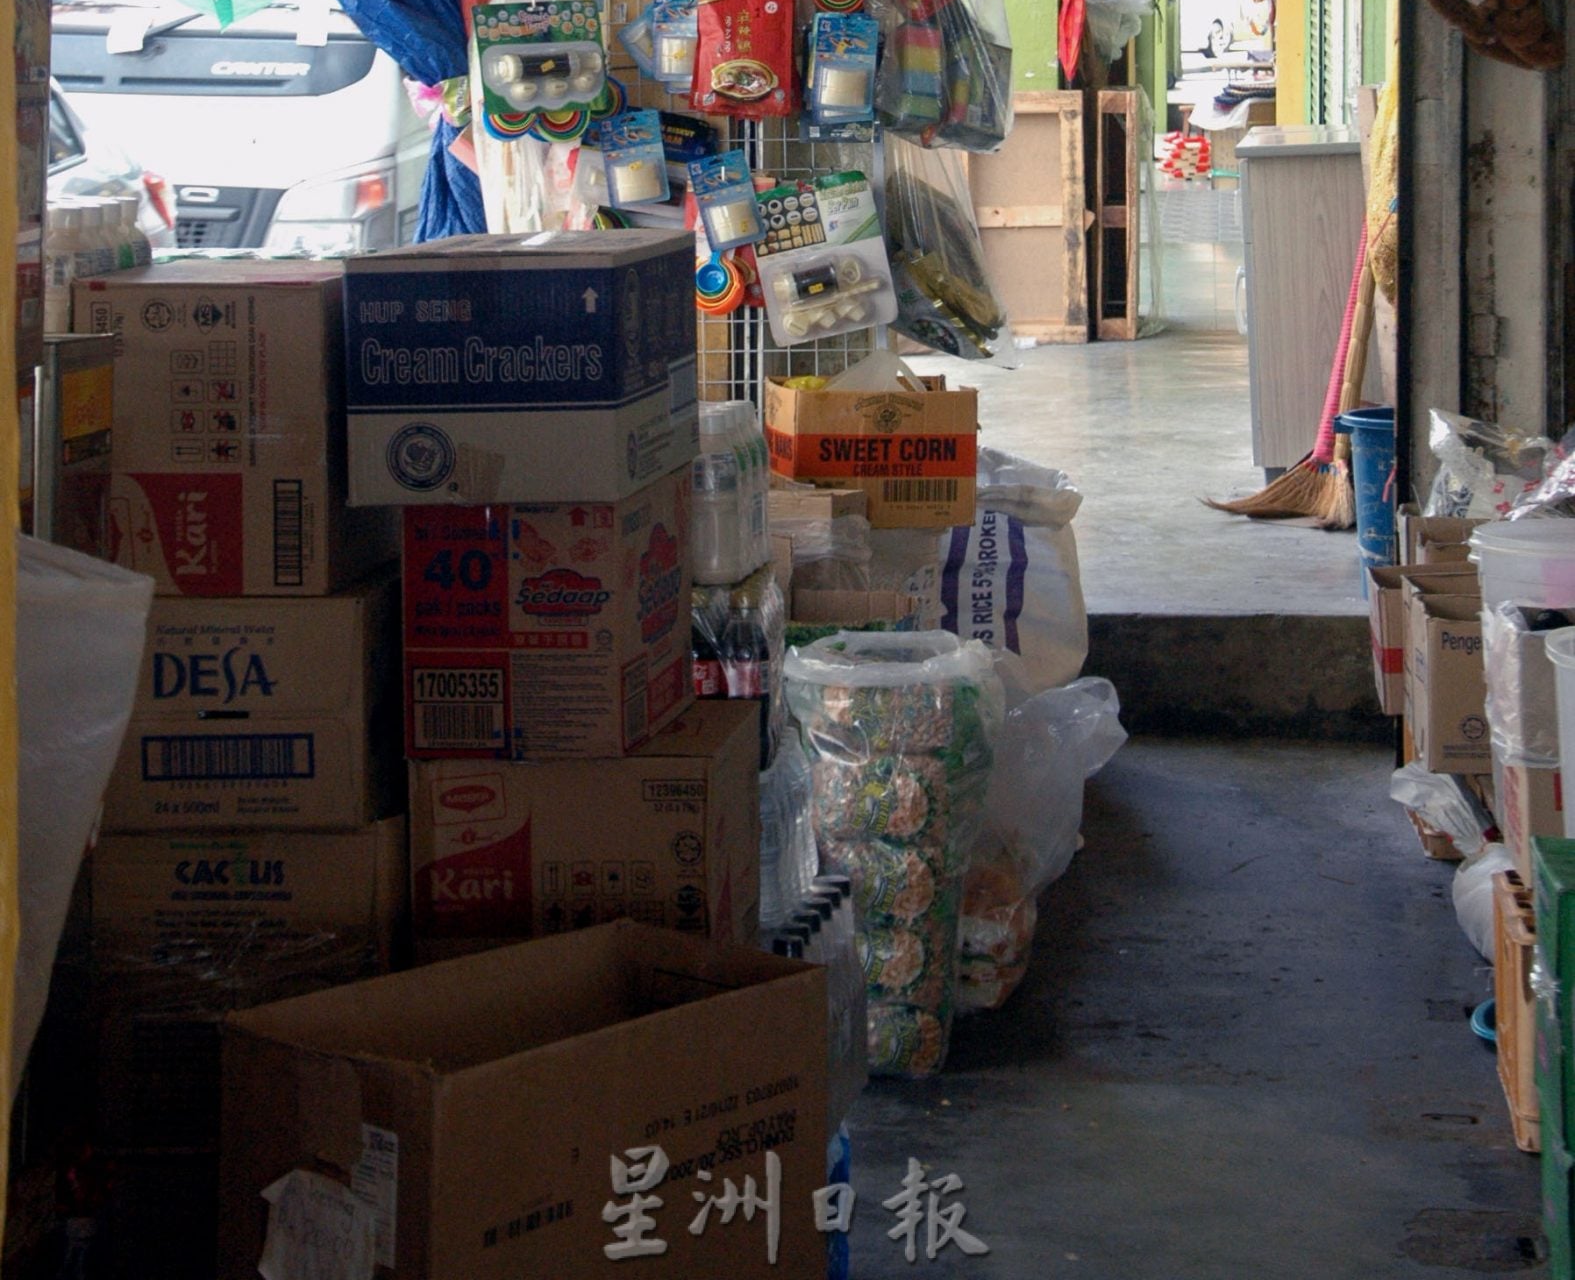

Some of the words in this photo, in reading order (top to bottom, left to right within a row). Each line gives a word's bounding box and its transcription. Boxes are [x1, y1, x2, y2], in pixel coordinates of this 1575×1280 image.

[360, 300, 405, 324] HUP
[416, 298, 473, 322] SENG
[360, 337, 460, 386] Cream
[463, 334, 603, 384] Crackers
[818, 437, 893, 462] SWEET
[899, 437, 957, 462] CORN
[853, 463, 889, 478] CREAM
[891, 463, 923, 476] STYLE
[174, 491, 209, 576] Kari
[423, 548, 493, 591] 40
[514, 583, 611, 608] Sedaap
[971, 591, 993, 625] RICE
[153, 645, 277, 705] DESA
[416, 671, 499, 699] 17005355
[430, 865, 514, 901] Kari
